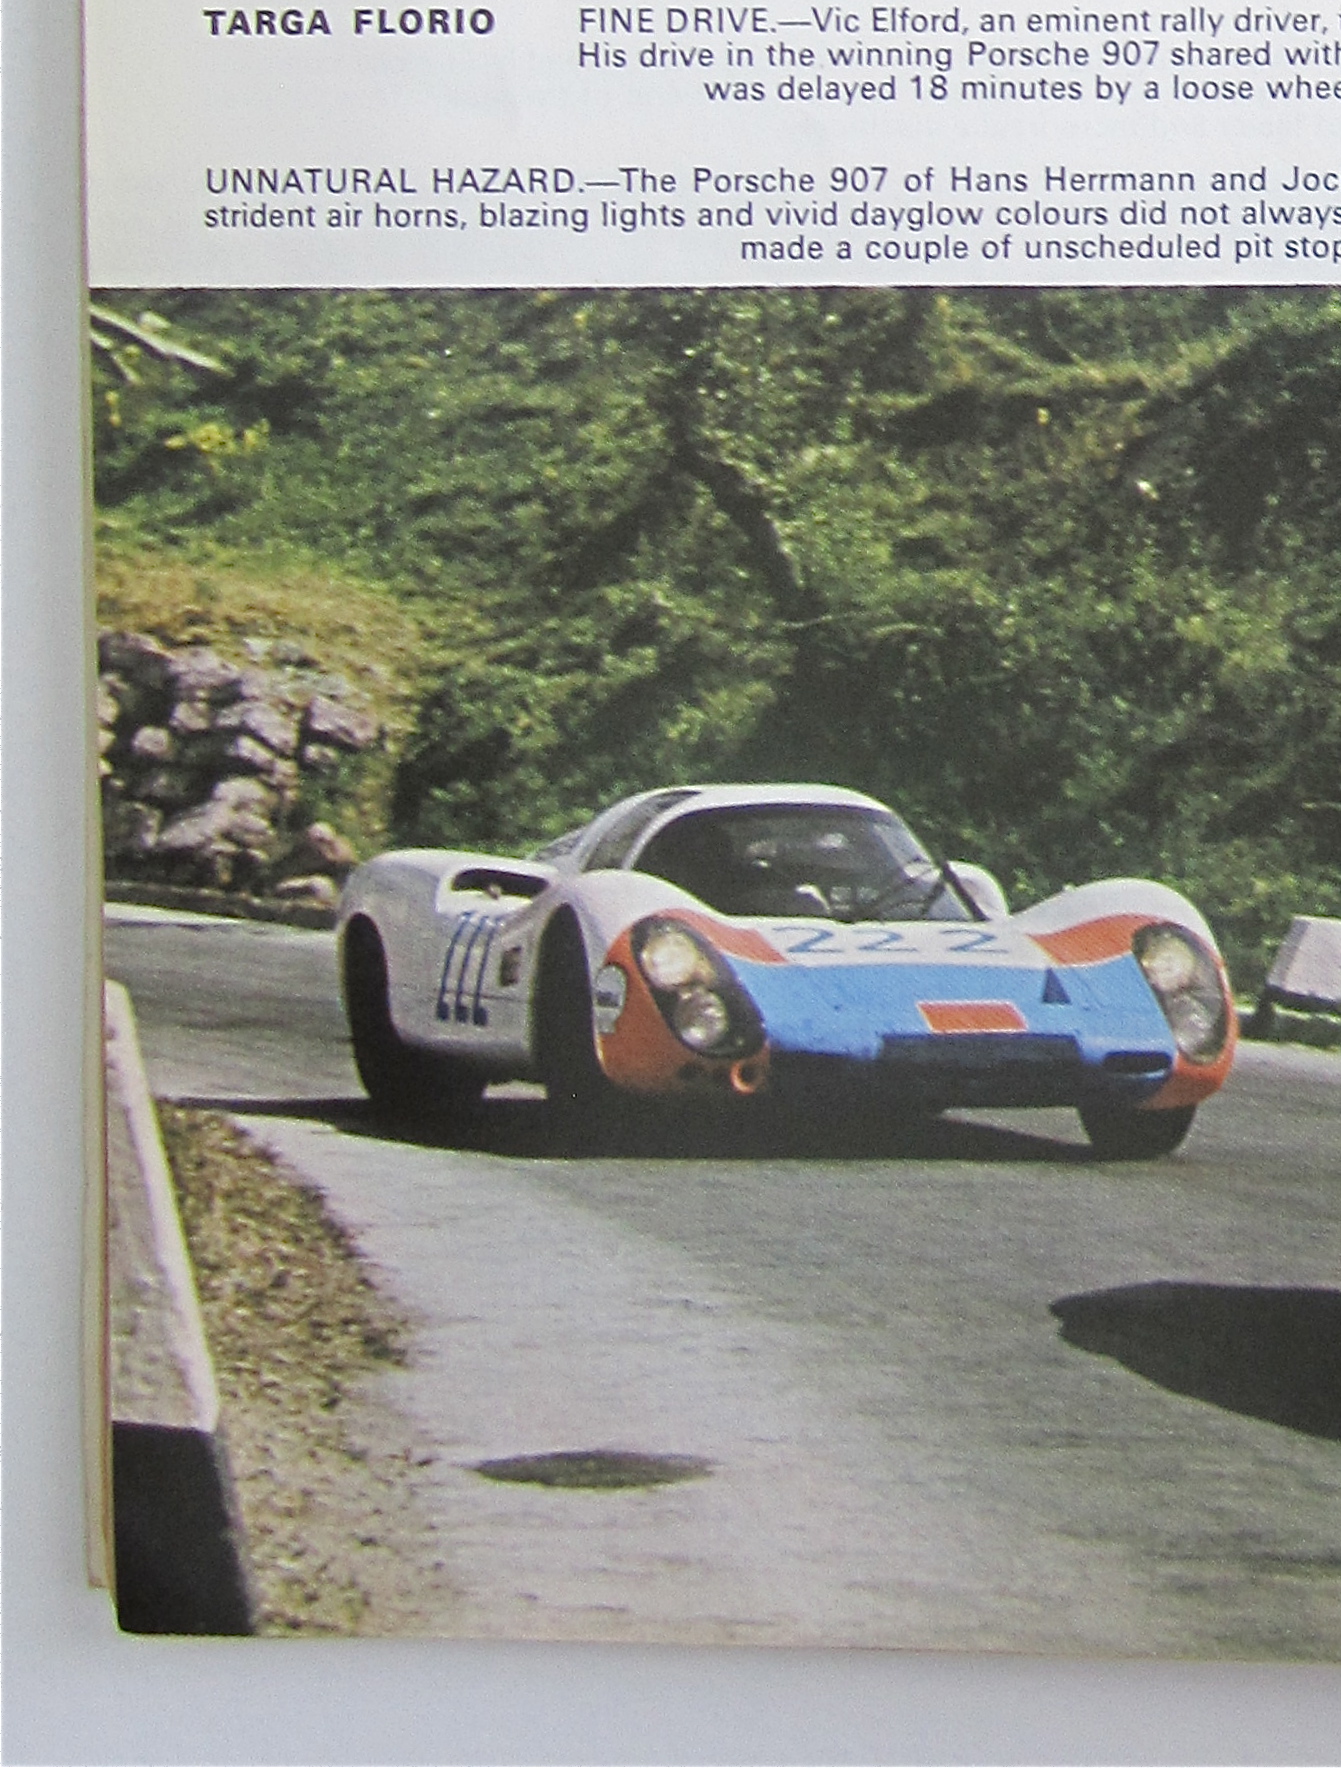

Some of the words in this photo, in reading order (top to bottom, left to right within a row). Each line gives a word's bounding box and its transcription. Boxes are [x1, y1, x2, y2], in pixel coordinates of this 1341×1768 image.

[202, 8, 333, 37] TARGA
[353, 7, 496, 36] FLORIO
[579, 7, 655, 34] FINE
[871, 6, 970, 36] Elford,
[979, 13, 1016, 33] an
[1026, 5, 1152, 33] eminent
[1160, 6, 1225, 38] rally
[1233, 6, 1329, 36] driver,
[578, 41, 628, 69] His
[638, 40, 715, 69] drive
[726, 40, 754, 67] in
[765, 40, 816, 68] the
[826, 40, 953, 73] winning
[967, 40, 1090, 67] Porsche
[1102, 39, 1161, 67] 907
[1170, 39, 1272, 67] shared
[703, 81, 766, 102] was
[776, 74, 897, 107] delayed
[909, 73, 949, 101] 18
[961, 73, 1083, 101] minutes
[1095, 73, 1133, 106] by
[1143, 80, 1160, 101] a
[1173, 73, 1254, 101] loose
[206, 167, 418, 195] UNNATURAL
[693, 166, 816, 194] Porsche
[829, 165, 889, 193] 907
[903, 165, 935, 193] of
[950, 165, 1029, 193] Hans
[1044, 165, 1196, 193] Herrmann
[1210, 165, 1267, 192] and
[203, 201, 317, 229] strident
[326, 200, 364, 229] air
[374, 201, 468, 231] horns,
[479, 200, 589, 234] blazing
[600, 200, 687, 234] lights
[696, 200, 754, 228] and
[764, 199, 838, 227] vivid
[849, 200, 984, 233] dayglow
[995, 199, 1109, 226] colours
[1119, 198, 1167, 226] did
[1180, 202, 1231, 226] not
[740, 233, 824, 261] made
[835, 240, 853, 261] a
[864, 233, 969, 265] couple
[980, 232, 1013, 260] of
[1024, 232, 1221, 260] unscheduled
[1234, 232, 1274, 265] pit
[771, 925, 1009, 954] 222
